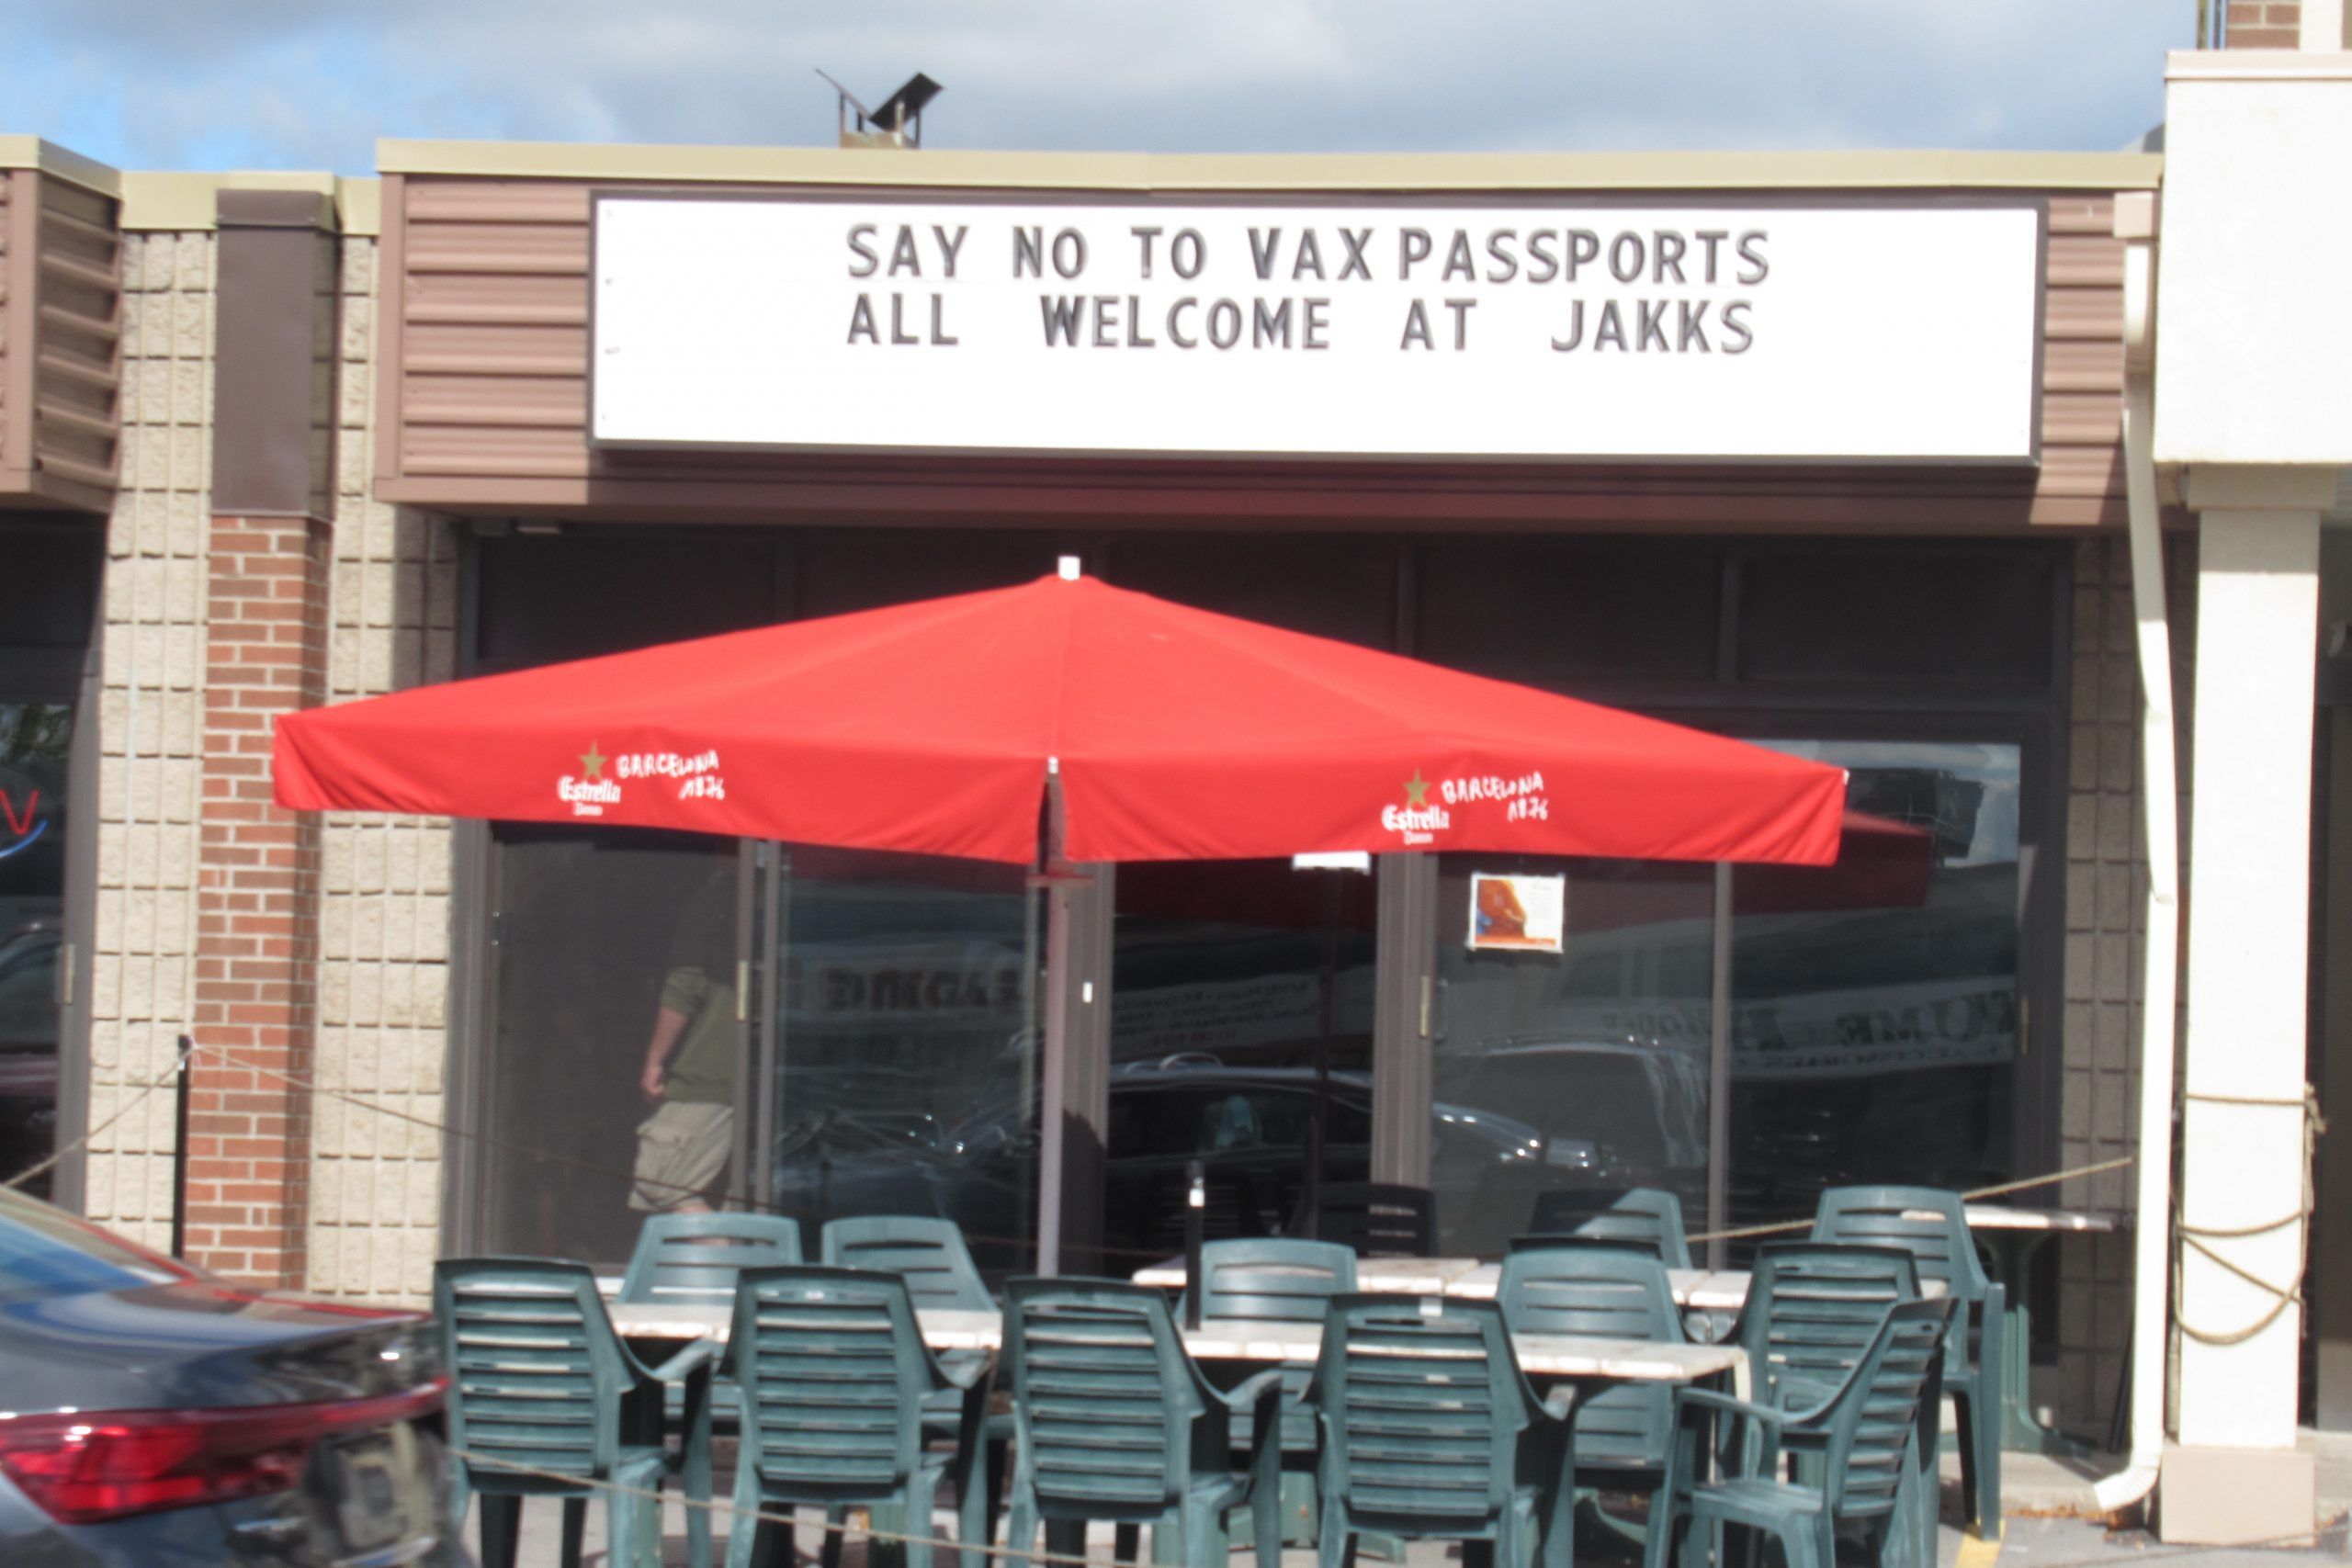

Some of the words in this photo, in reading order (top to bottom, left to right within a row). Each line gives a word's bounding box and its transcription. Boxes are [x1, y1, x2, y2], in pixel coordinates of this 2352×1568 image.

[847, 223, 969, 280] SAY
[1012, 225, 1089, 280] NO
[1130, 226, 1207, 281] TO
[1247, 227, 1374, 281] VAX
[1398, 227, 1770, 287] PASSPORTS
[847, 292, 960, 347] ALL
[1039, 294, 1331, 351] WELCOME
[1399, 299, 1478, 352] AT
[1550, 299, 1755, 355] JAKKS
[616, 749, 719, 778] BARCELONA
[557, 775, 622, 803] Estrella
[1441, 771, 1544, 805] BARCELONA
[1382, 805, 1450, 831] Estrella
